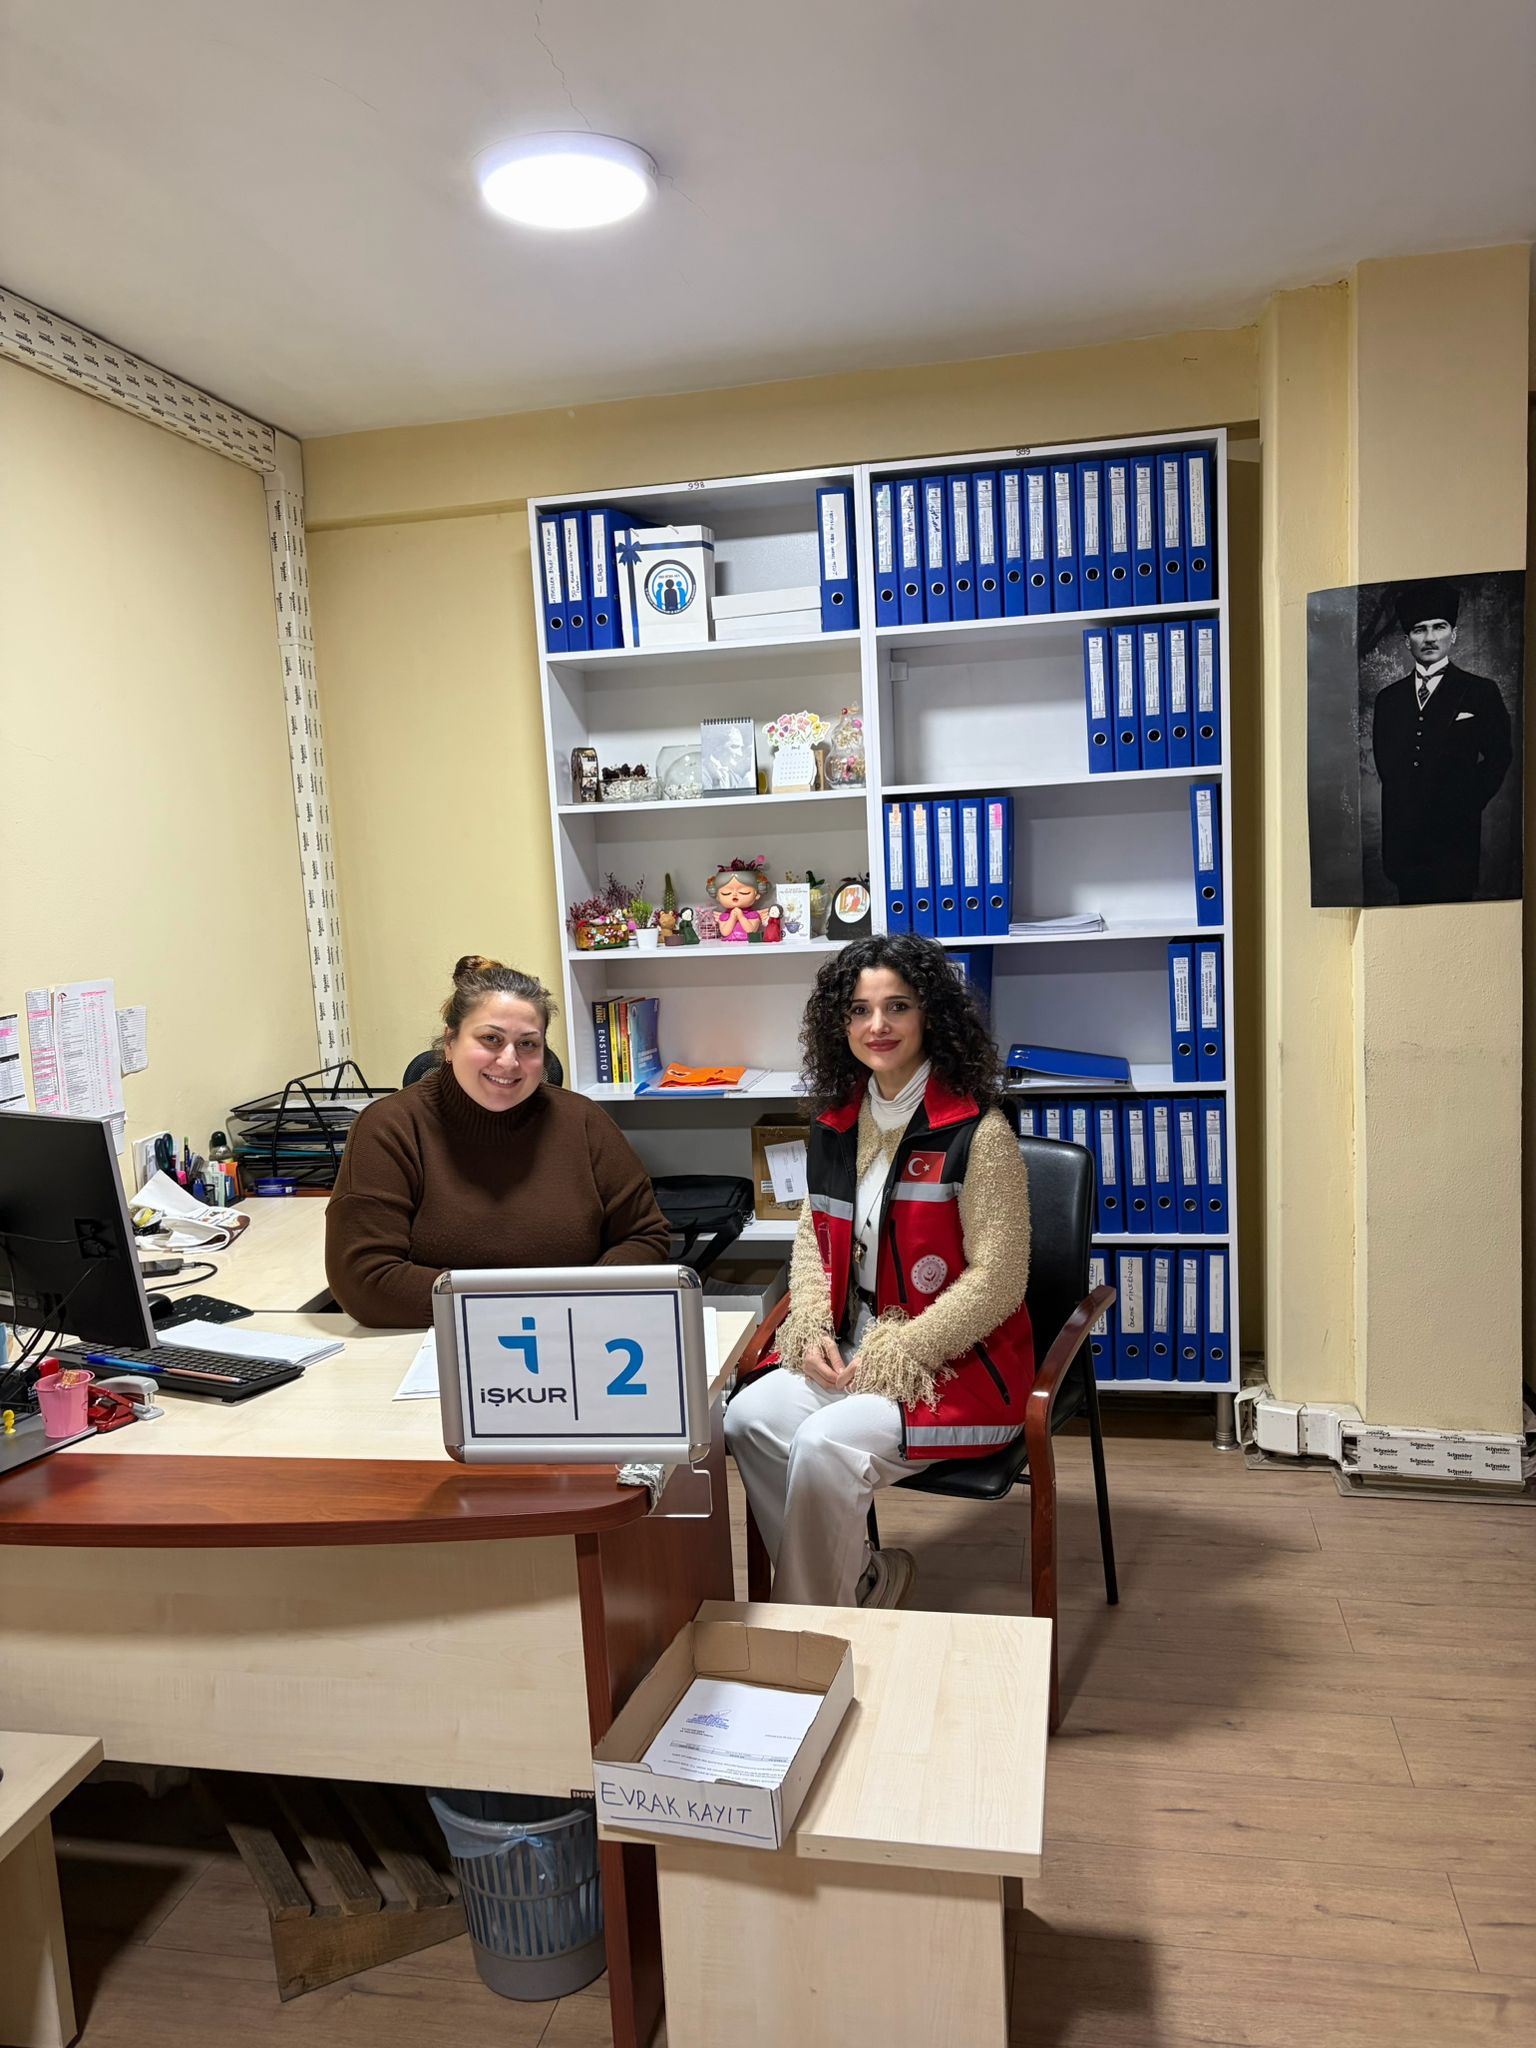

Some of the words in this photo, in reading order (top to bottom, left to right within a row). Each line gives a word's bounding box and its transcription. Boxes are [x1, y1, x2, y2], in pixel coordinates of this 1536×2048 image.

[605, 1338, 647, 1396] 2
[600, 1782, 680, 1818] EVRAK
[687, 1800, 752, 1825] KAYIT
